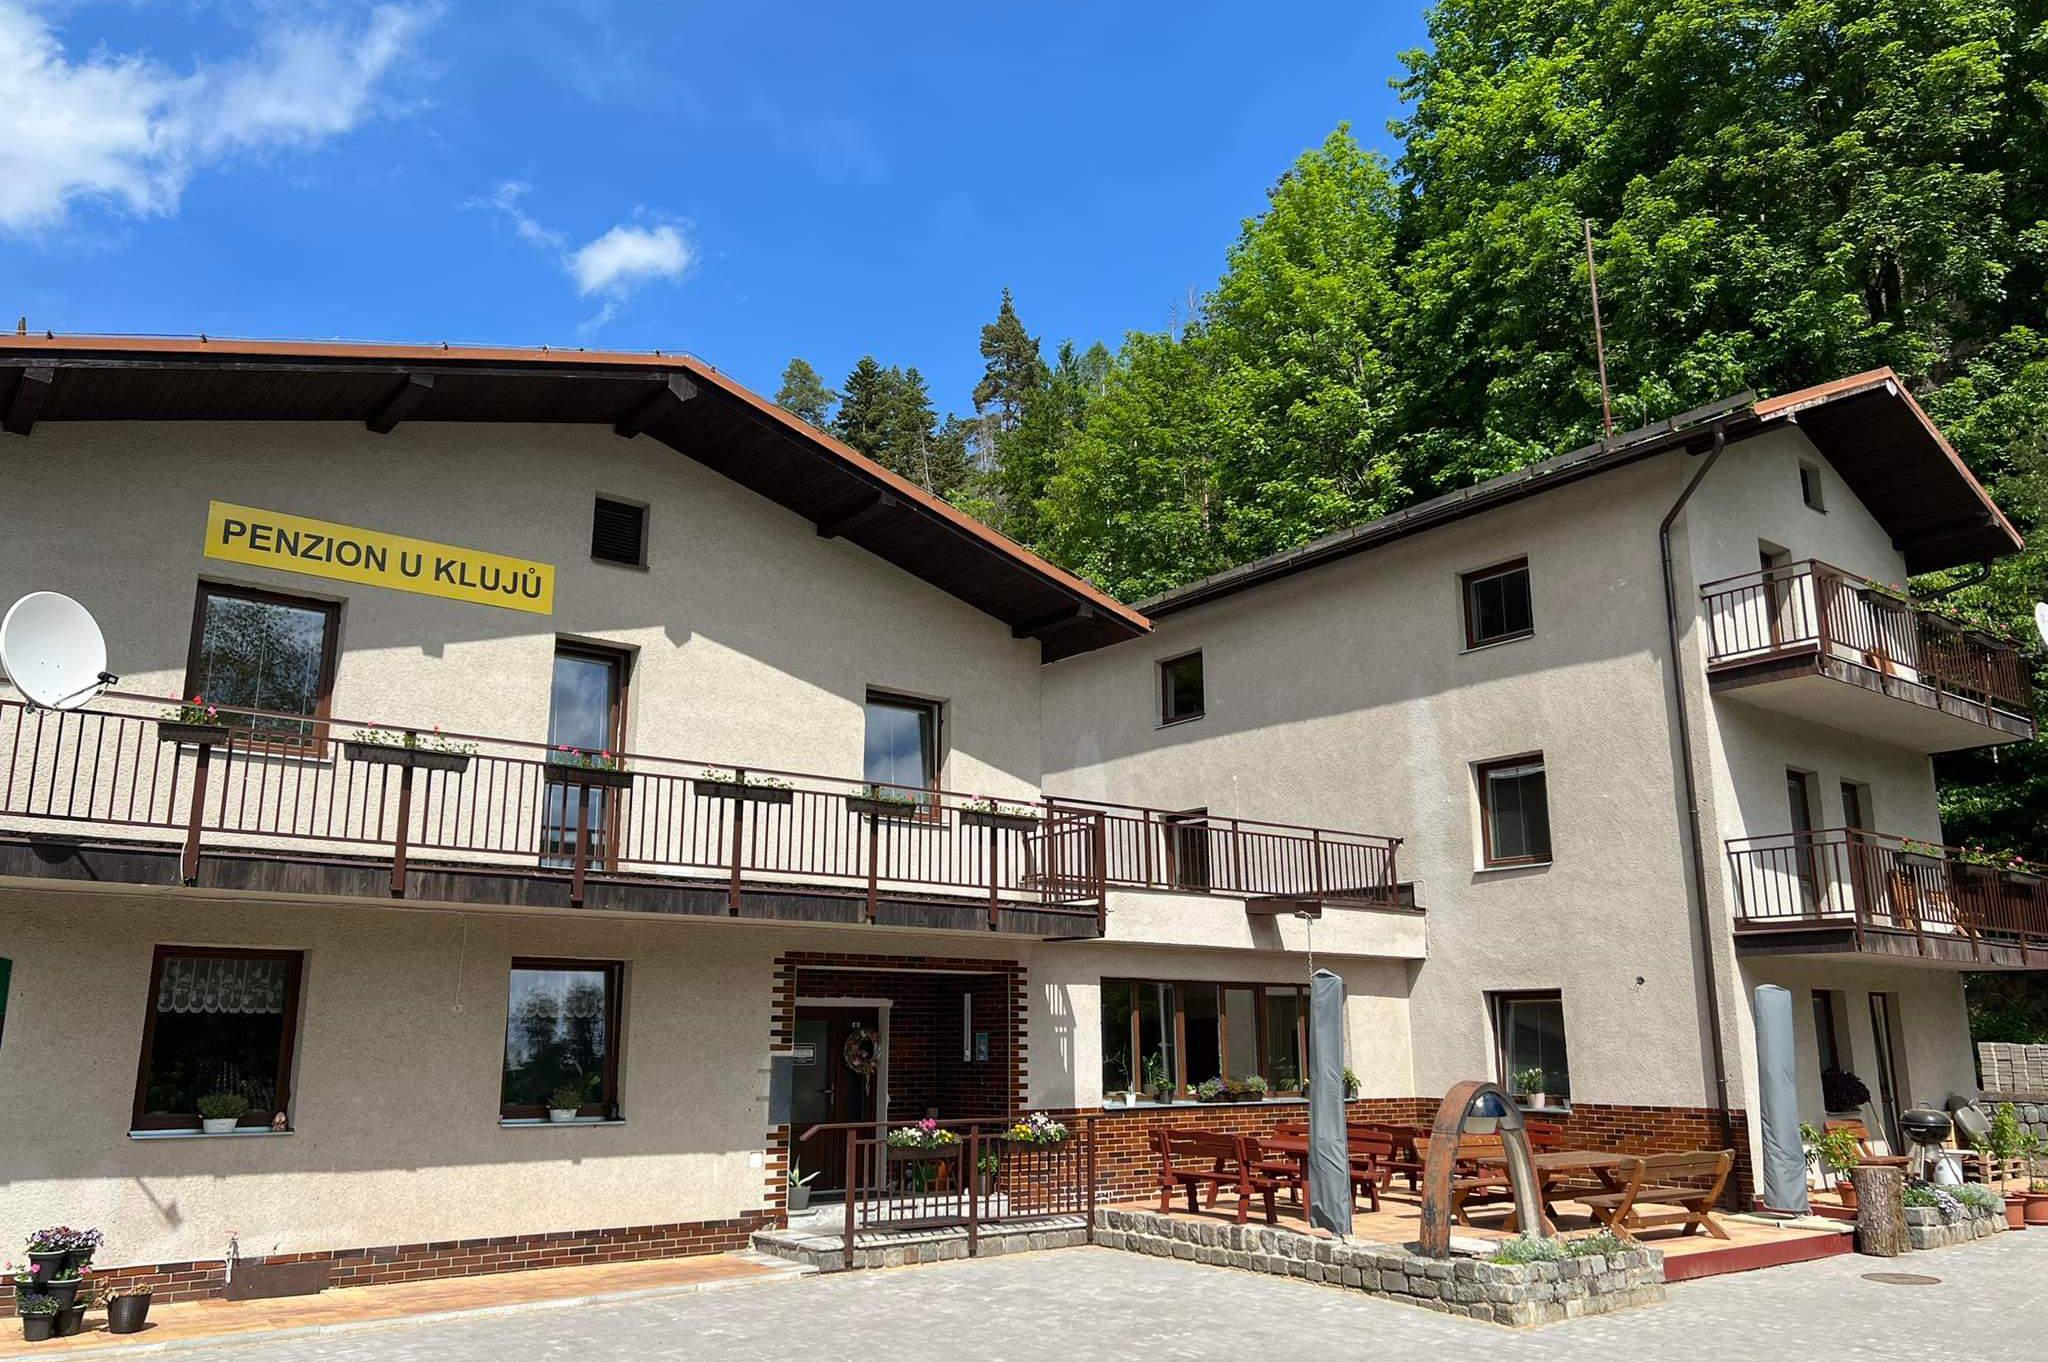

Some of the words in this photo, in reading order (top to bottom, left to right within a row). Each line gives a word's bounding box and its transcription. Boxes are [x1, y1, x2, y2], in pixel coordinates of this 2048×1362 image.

[222, 518, 387, 573] PENZION
[400, 551, 422, 578] U
[434, 557, 542, 599] KLUJŮ
